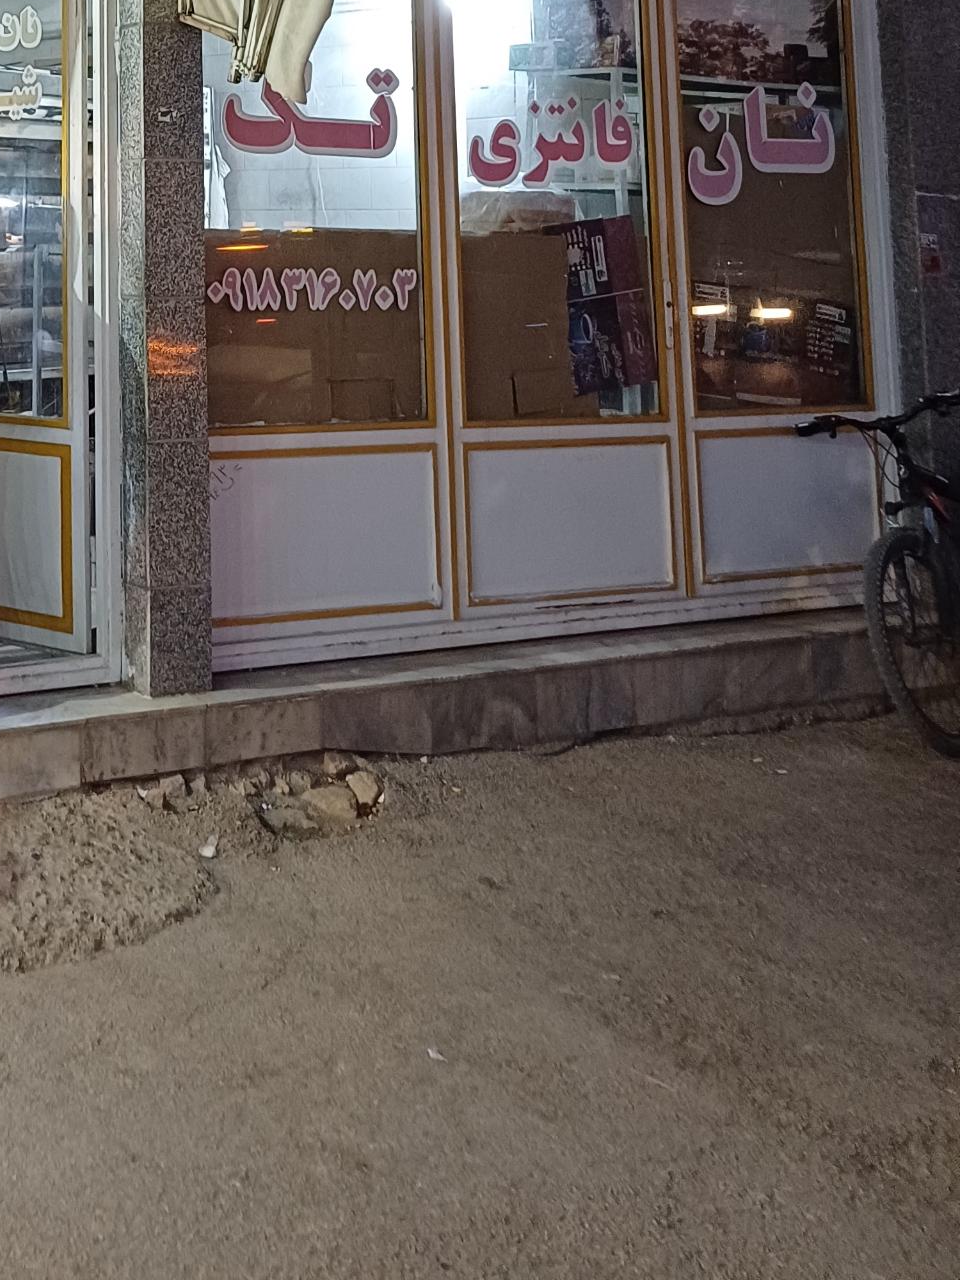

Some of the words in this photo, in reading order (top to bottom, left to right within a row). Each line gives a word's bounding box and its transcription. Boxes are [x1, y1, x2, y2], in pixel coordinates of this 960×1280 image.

[469, 96, 634, 188] فانتزی
[688, 81, 835, 206] نان
[207, 268, 417, 311] ۰۹۱۸۳۱۶۰۷۰۳
